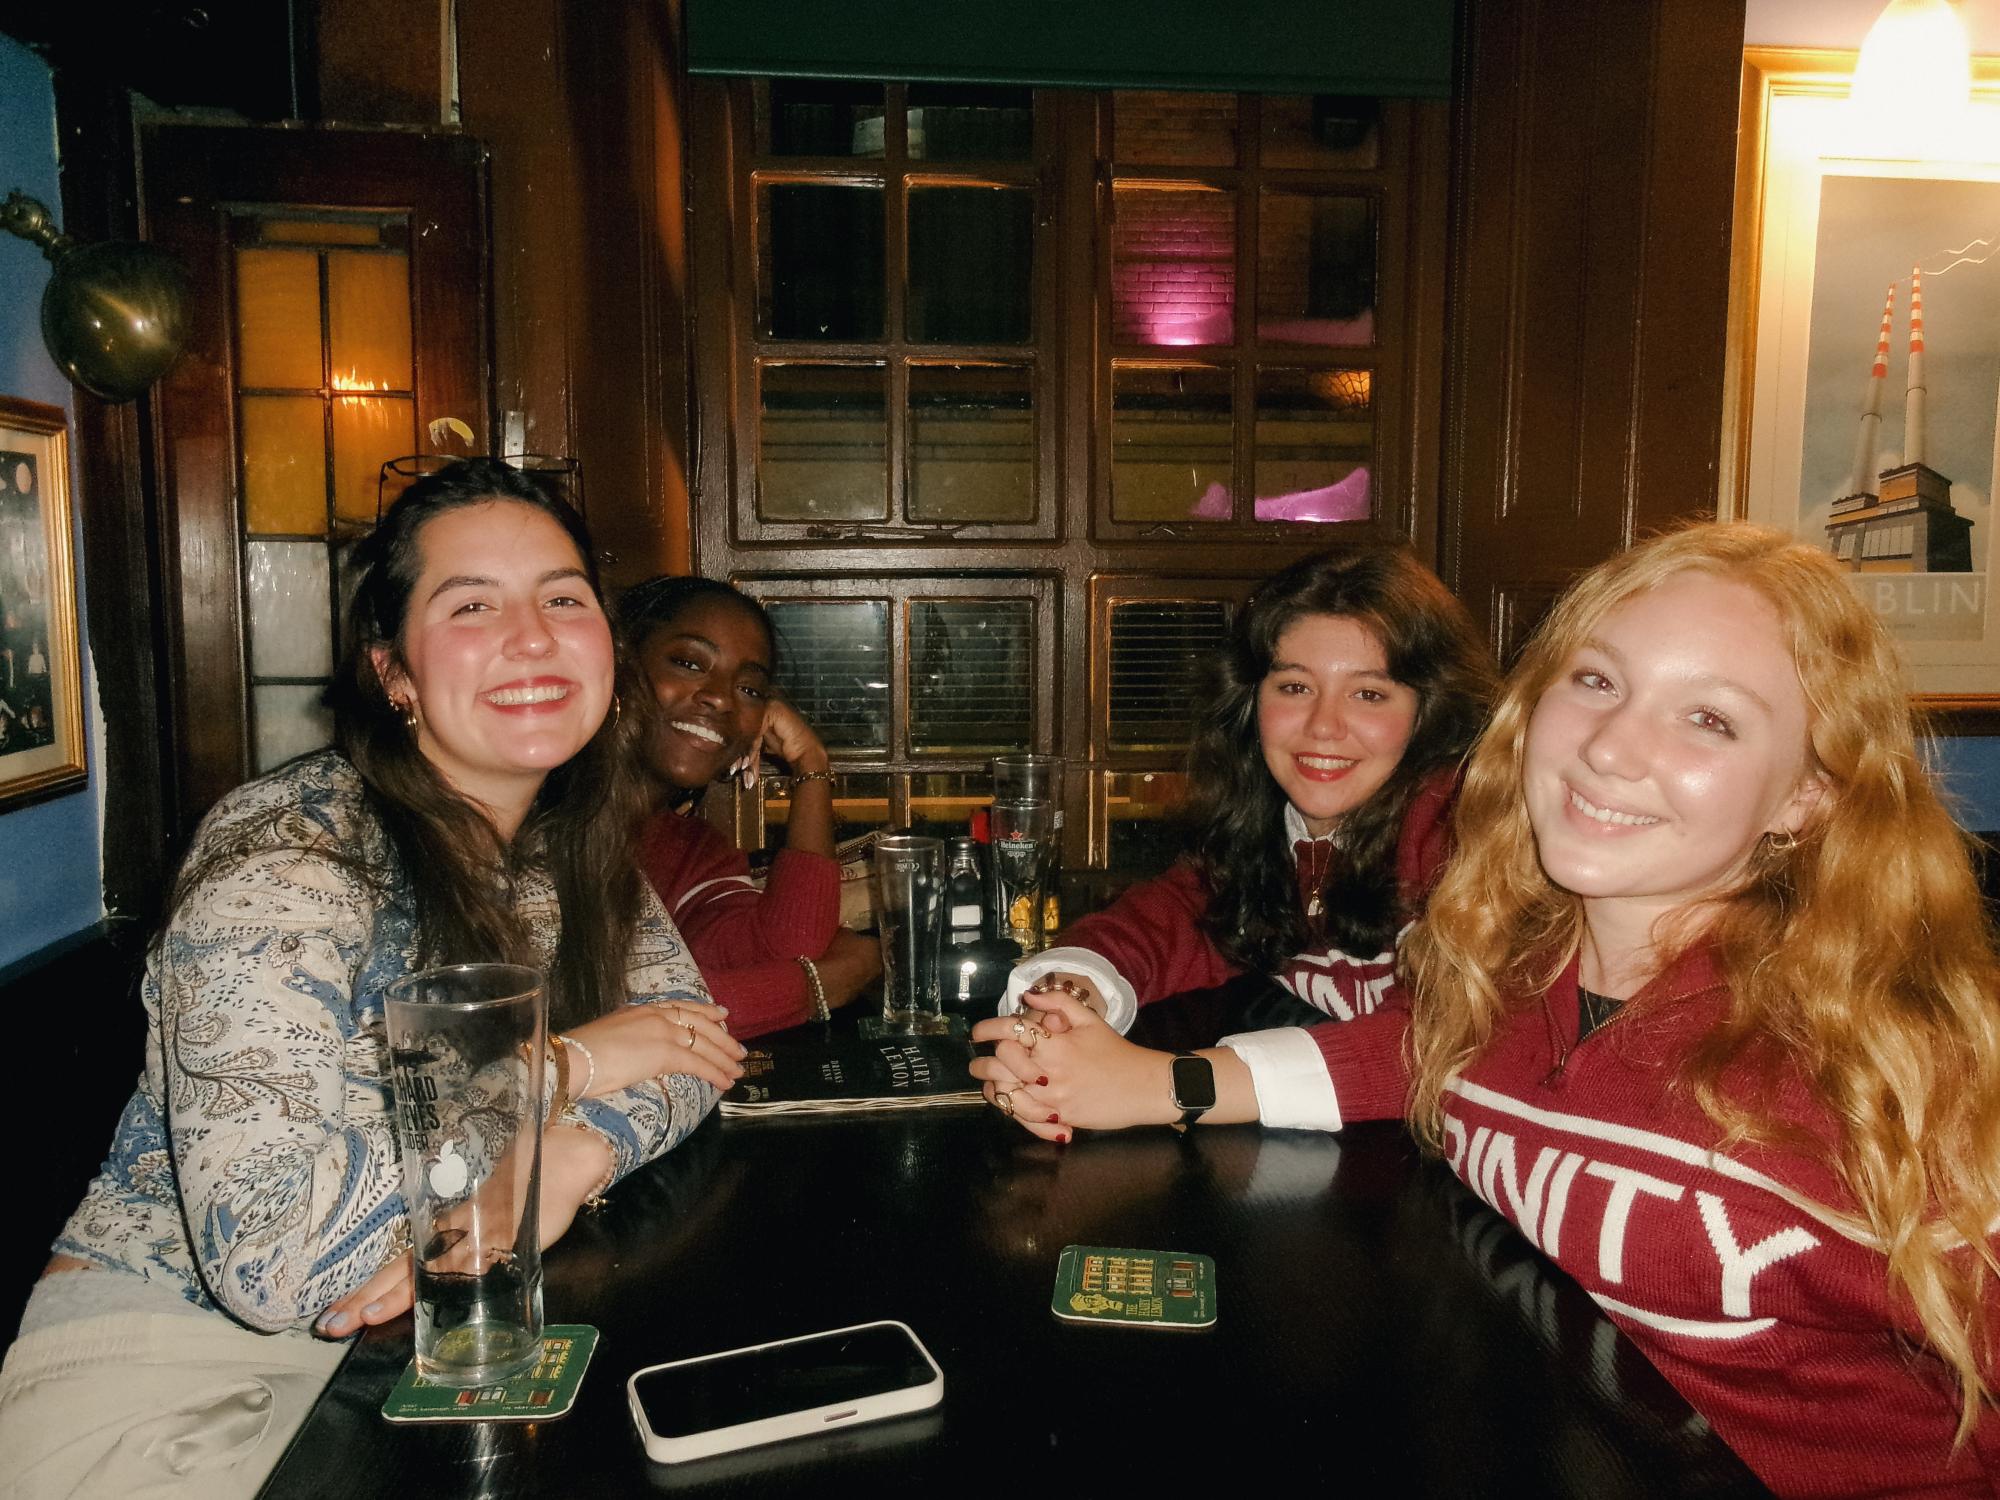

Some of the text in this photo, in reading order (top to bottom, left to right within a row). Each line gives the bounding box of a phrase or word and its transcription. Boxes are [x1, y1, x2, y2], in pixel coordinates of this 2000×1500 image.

[1875, 582, 1980, 614] BLIN
[1000, 841, 1034, 849] Heineken
[830, 1060, 844, 1083] DRINKS
[879, 1045, 909, 1088] LEMON
[901, 1045, 930, 1084] HAIRY
